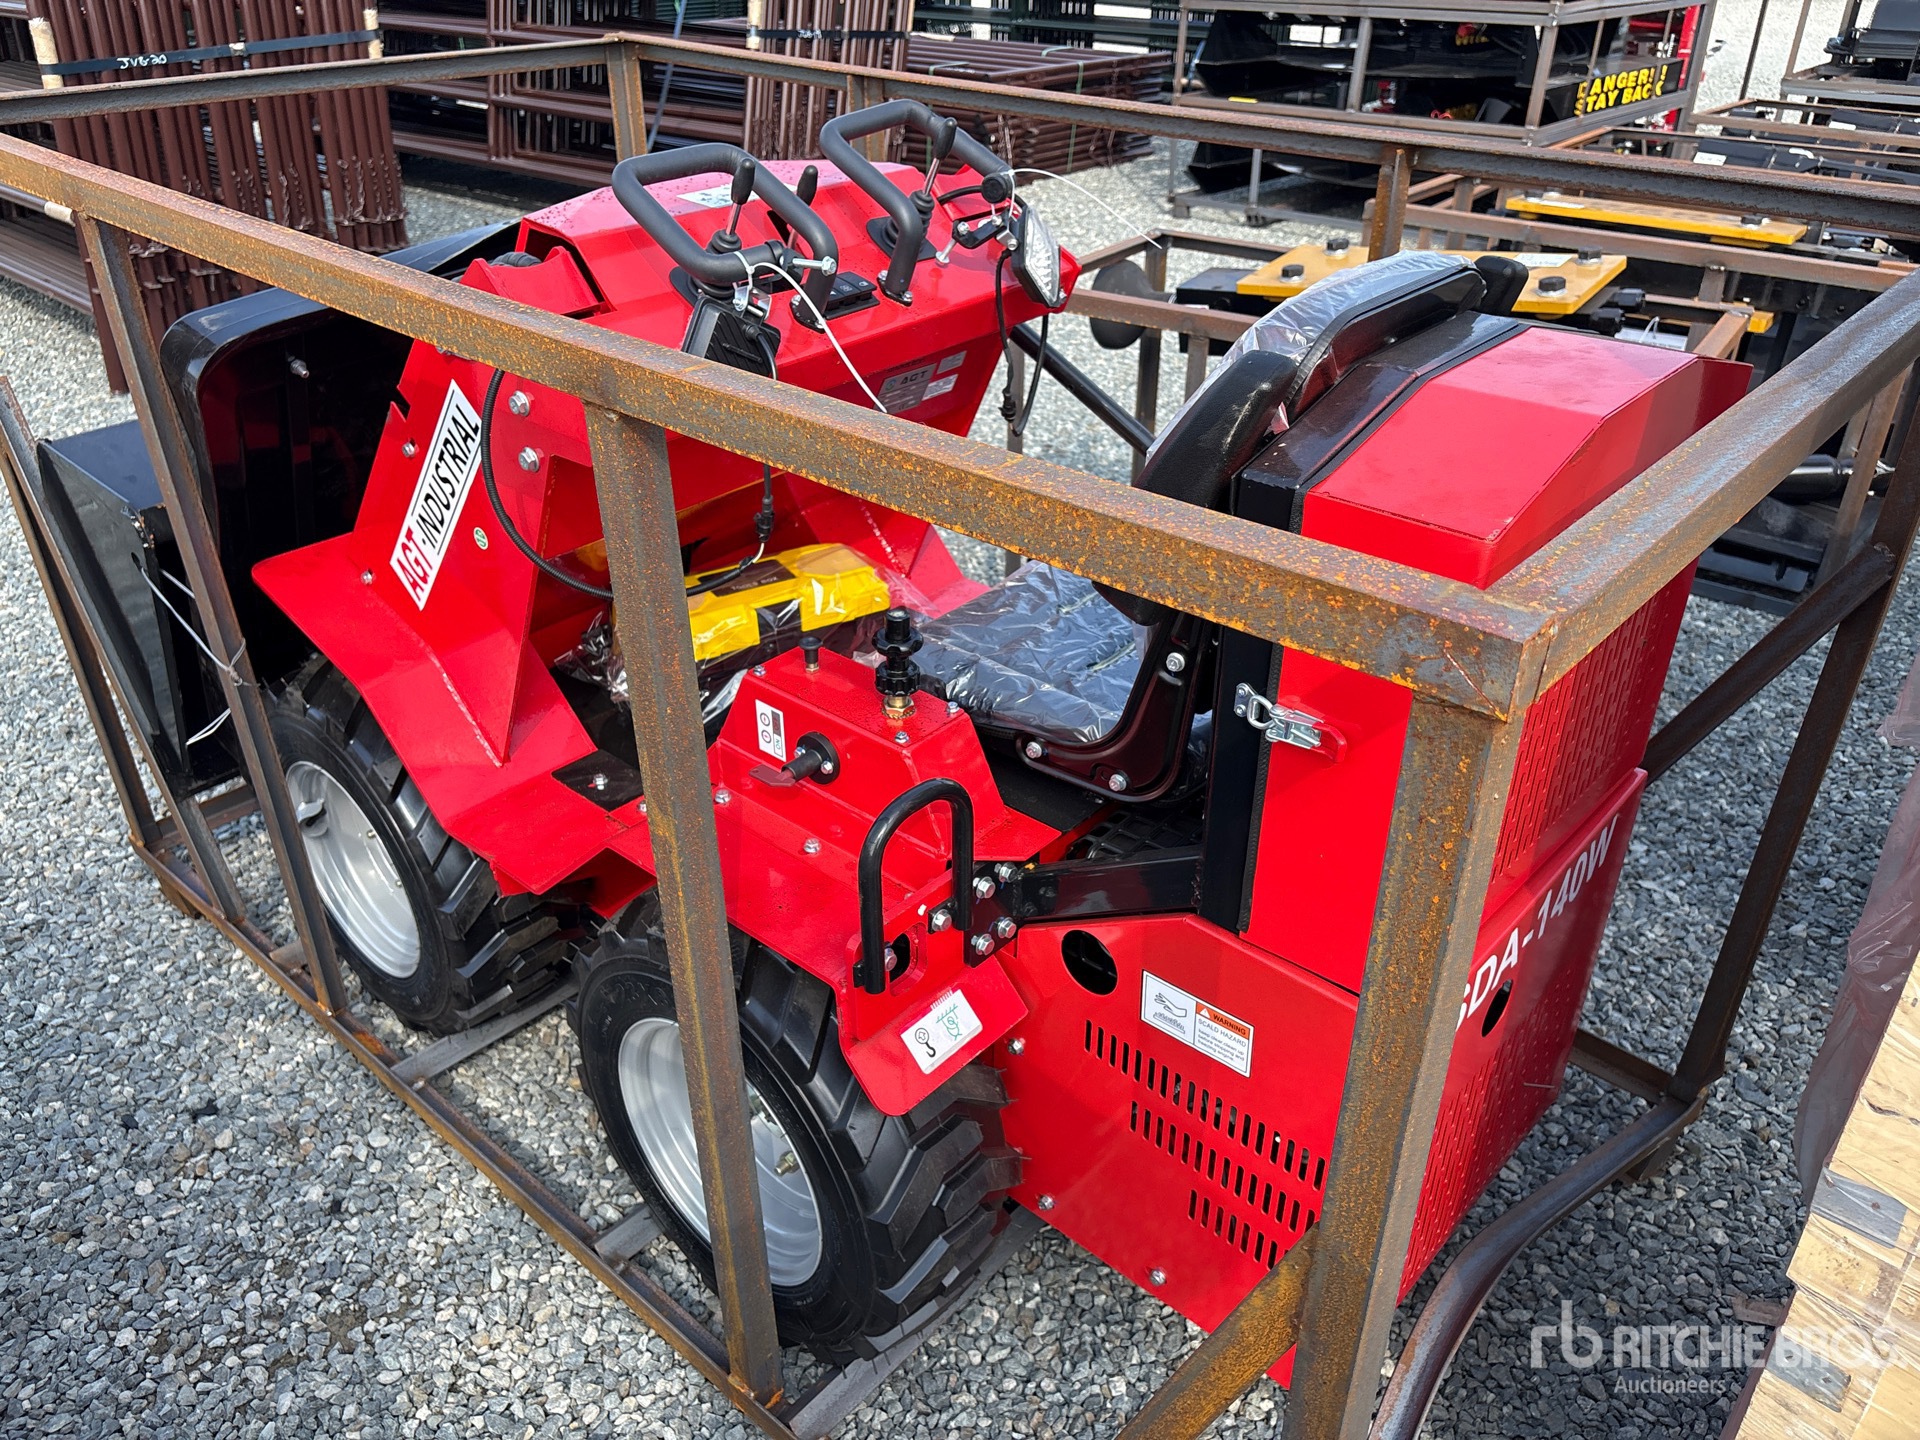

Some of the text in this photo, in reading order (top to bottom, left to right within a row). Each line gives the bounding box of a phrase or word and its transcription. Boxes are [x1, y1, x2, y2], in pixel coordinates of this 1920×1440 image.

[1574, 89, 1619, 116] STAY
[900, 370, 928, 384] AGT
[396, 404, 480, 602] AGT INDUSTRIAL
[1198, 1018, 1246, 1047] SCALD HAZARD
[1213, 1013, 1246, 1035] WARNING
[1198, 1034, 1245, 1061] before stopping and
